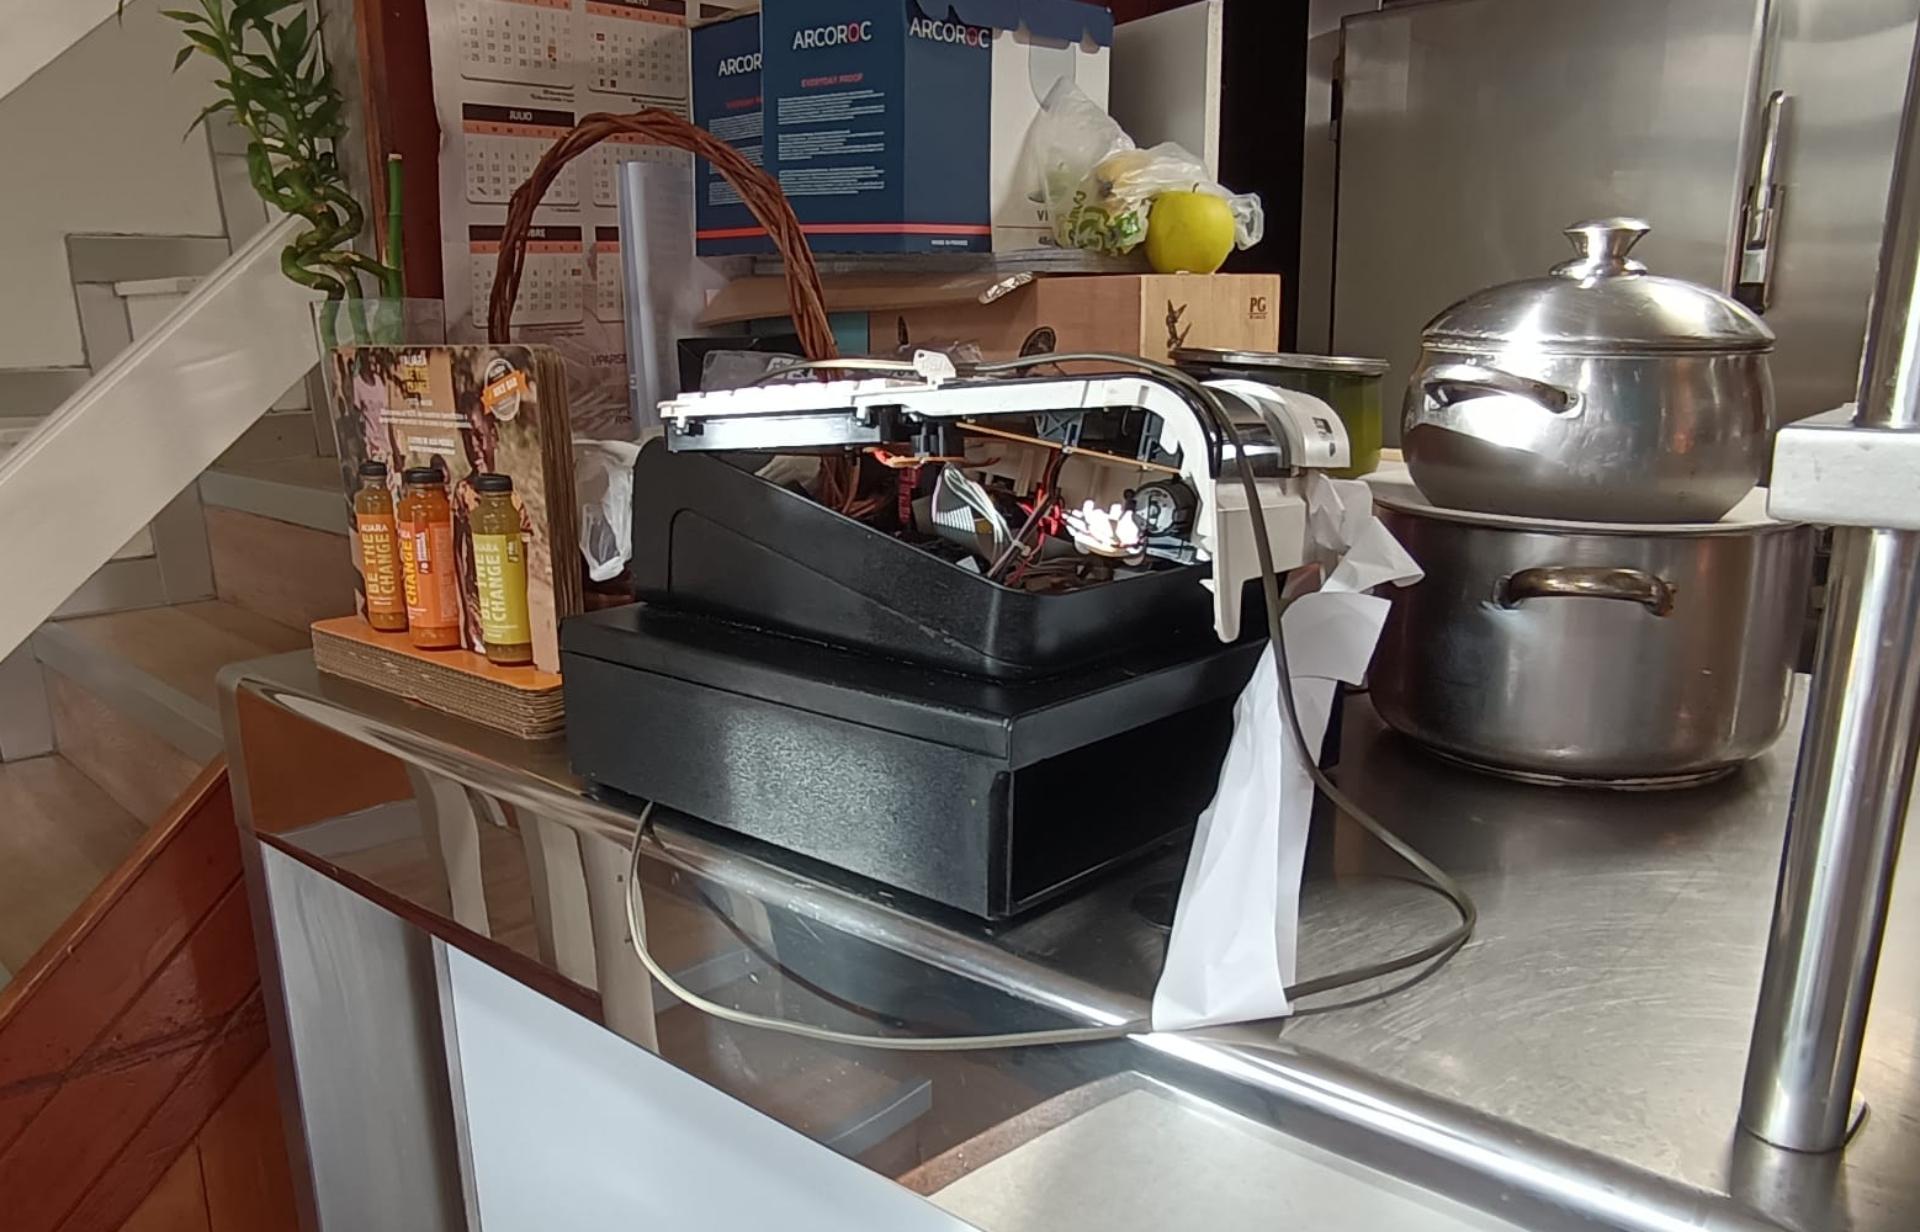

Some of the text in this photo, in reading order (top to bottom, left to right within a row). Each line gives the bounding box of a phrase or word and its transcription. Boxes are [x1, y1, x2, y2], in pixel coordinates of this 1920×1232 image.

[792, 20, 872, 50] ARCOROC
[909, 17, 989, 48] ARCOROC
[718, 52, 762, 77] ARCOR
[510, 110, 533, 121] JULIO
[1249, 296, 1267, 313] PG
[361, 533, 379, 594] BE THE
[375, 533, 395, 594] CHANGE
[403, 540, 418, 606] CHANGE
[476, 553, 488, 588] THE
[486, 554, 507, 622] CHANGE
